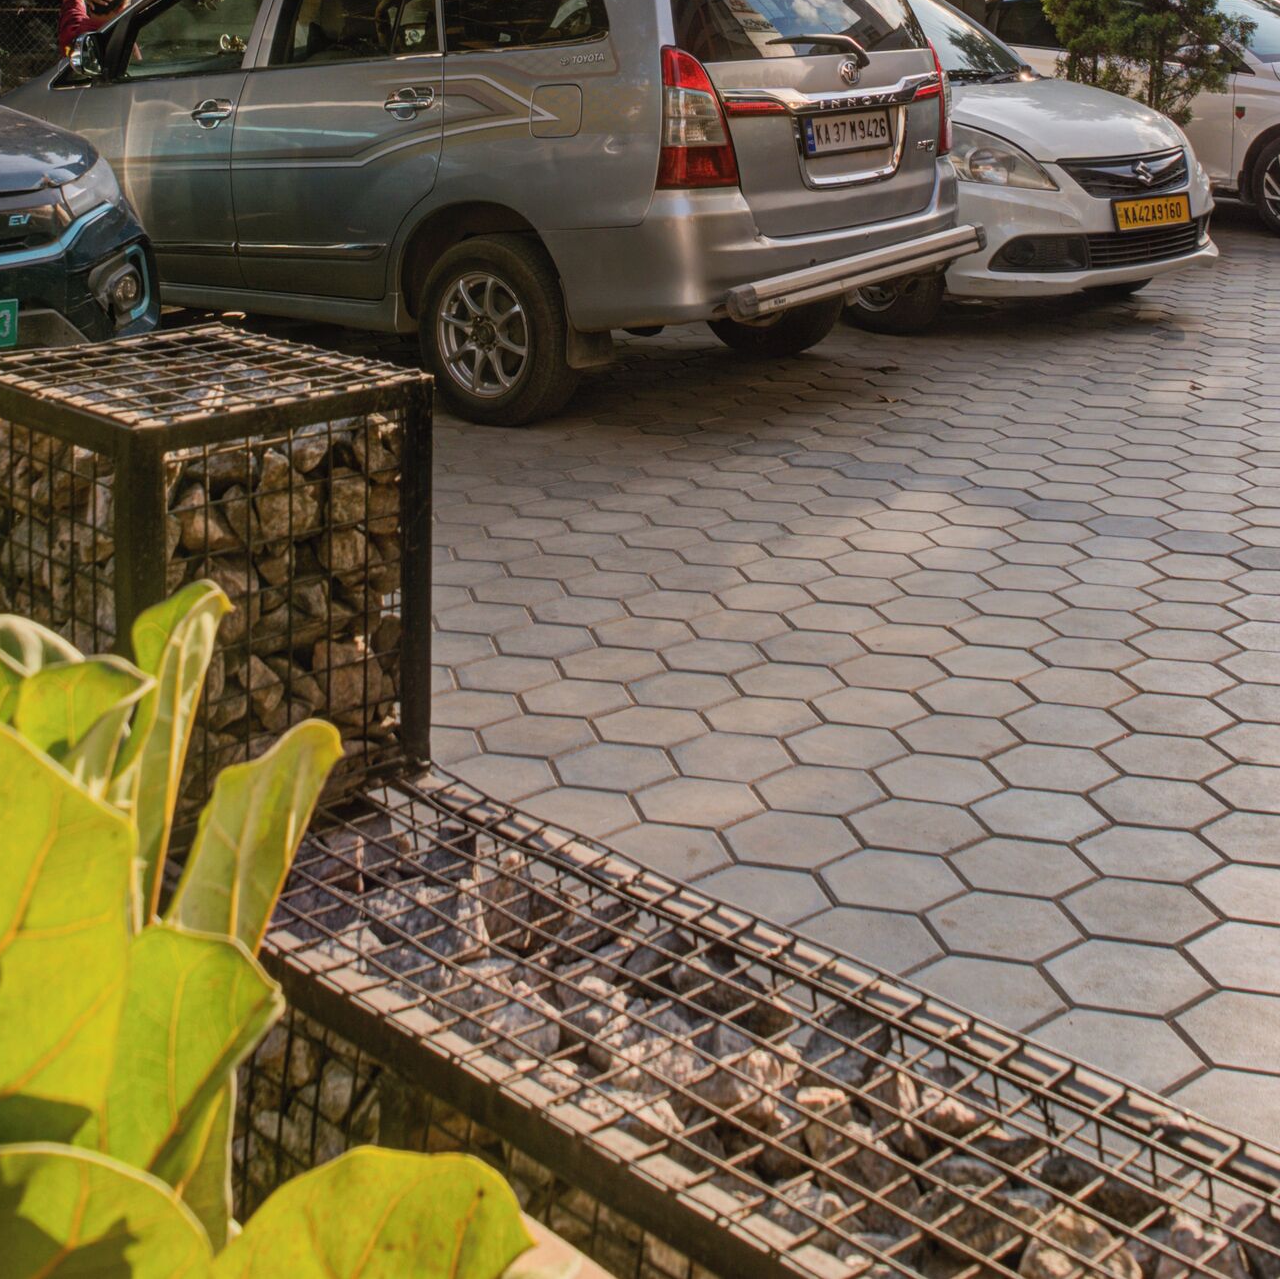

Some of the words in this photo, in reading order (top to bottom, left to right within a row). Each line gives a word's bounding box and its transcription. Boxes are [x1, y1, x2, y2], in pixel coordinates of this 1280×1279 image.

[572, 52, 605, 64] TOYOTA
[819, 94, 898, 110] INNOVA
[8, 213, 32, 226] EV
